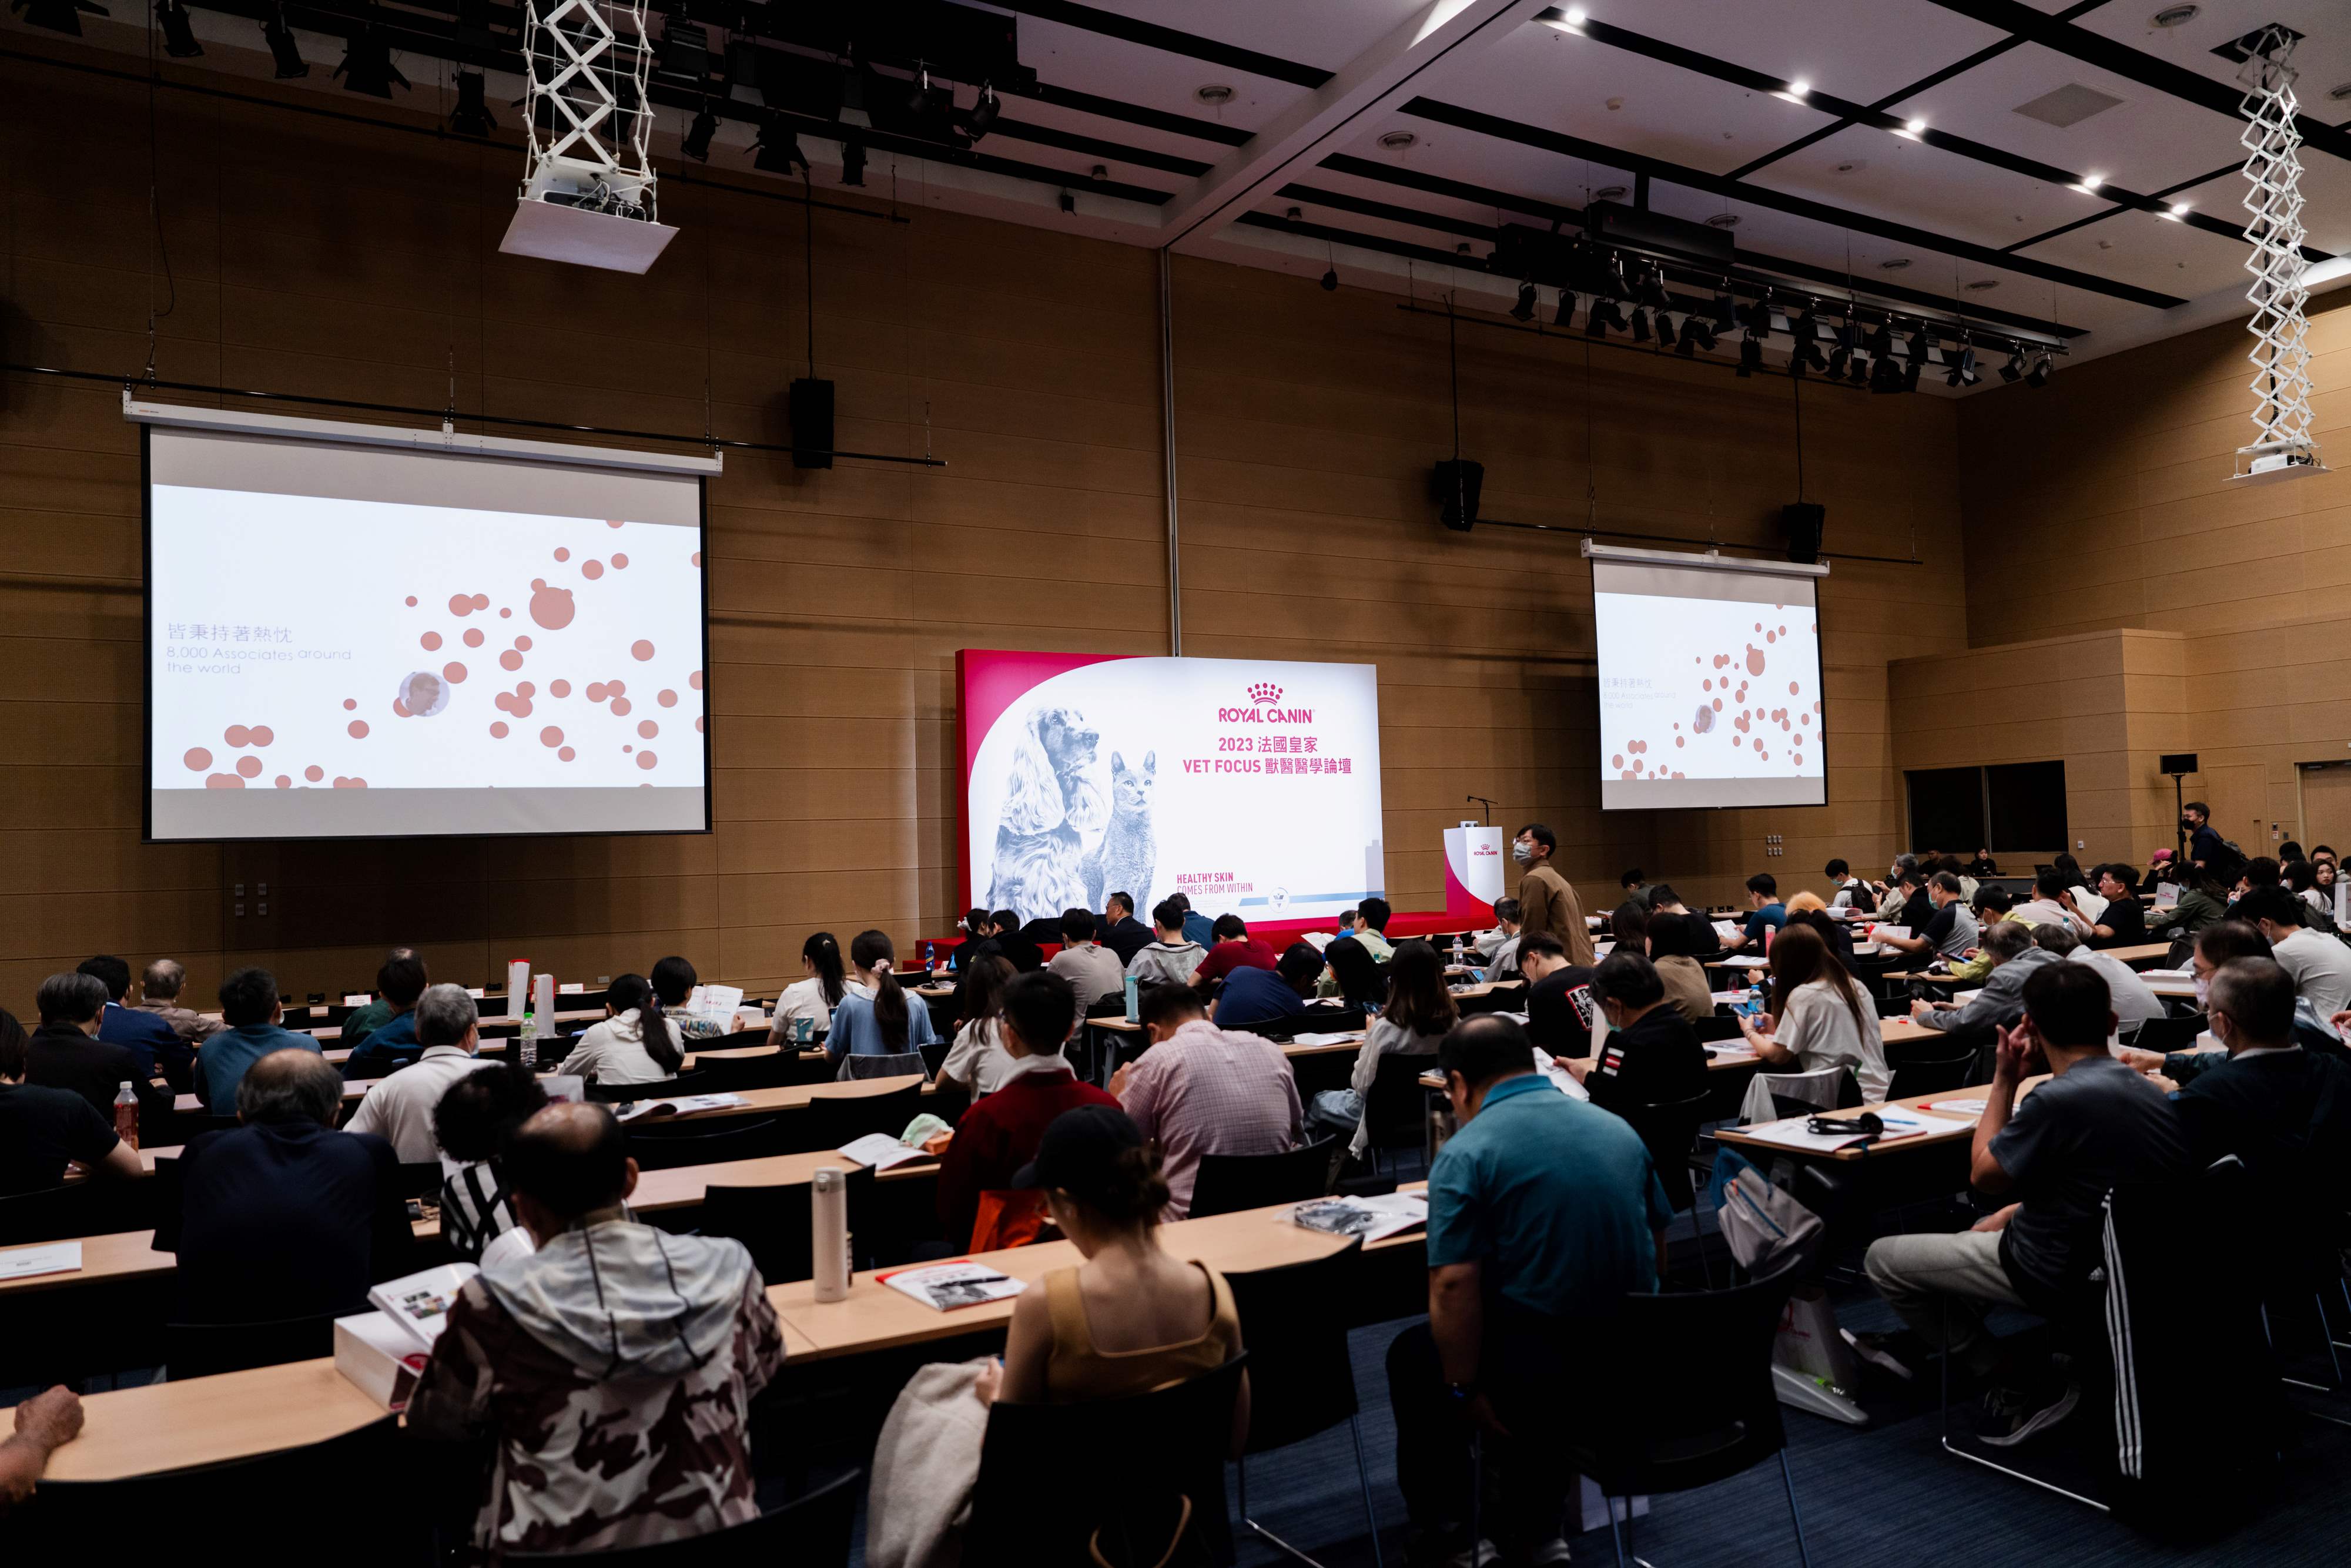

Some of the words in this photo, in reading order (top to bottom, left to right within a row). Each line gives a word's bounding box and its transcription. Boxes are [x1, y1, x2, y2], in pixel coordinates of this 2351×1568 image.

[168, 622, 293, 643] 皆秉持著熱忱
[166, 646, 207, 659] 8,000
[213, 648, 293, 661] Associates
[298, 649, 351, 659] around
[168, 662, 192, 673] the
[198, 664, 240, 674] world
[1218, 708, 1264, 723] ROYAL
[1267, 709, 1312, 723] CANIN
[1218, 738, 1253, 751] 2023
[1258, 736, 1318, 753] 法國皇家
[1183, 759, 1211, 773] VET
[1215, 759, 1261, 773] FOCUS
[1265, 758, 1352, 774] 獸醫醫學論壇
[1177, 873, 1212, 883] HEALTHY
[1215, 872, 1234, 882] SKIN
[1177, 884, 1203, 895] COMES
[1205, 883, 1225, 894] FROM
[1227, 882, 1253, 893] WITHIN
